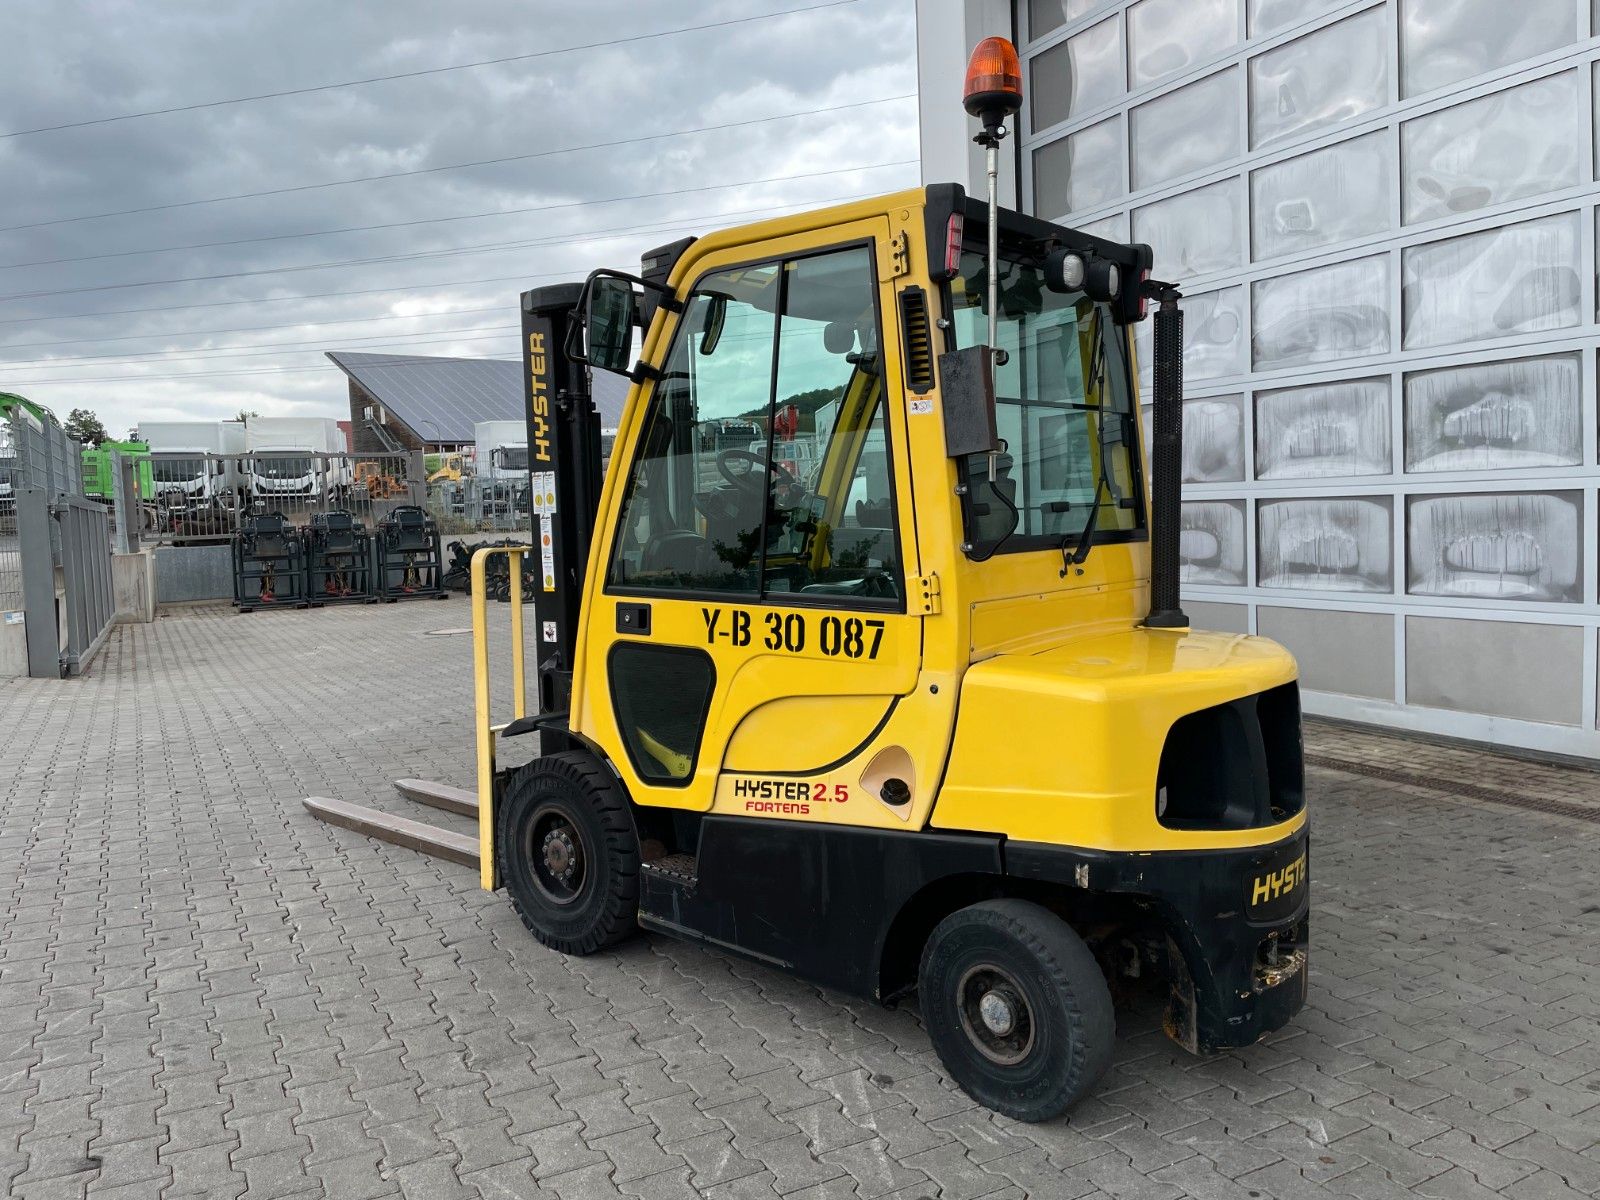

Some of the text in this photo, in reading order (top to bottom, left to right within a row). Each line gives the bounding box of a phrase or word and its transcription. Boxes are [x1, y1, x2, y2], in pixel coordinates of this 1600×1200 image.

[529, 332, 551, 462] HYSTER
[702, 608, 885, 660] Y-B 30 087
[734, 779, 849, 803] HYSTER 2.5
[745, 801, 810, 815] FORTENS
